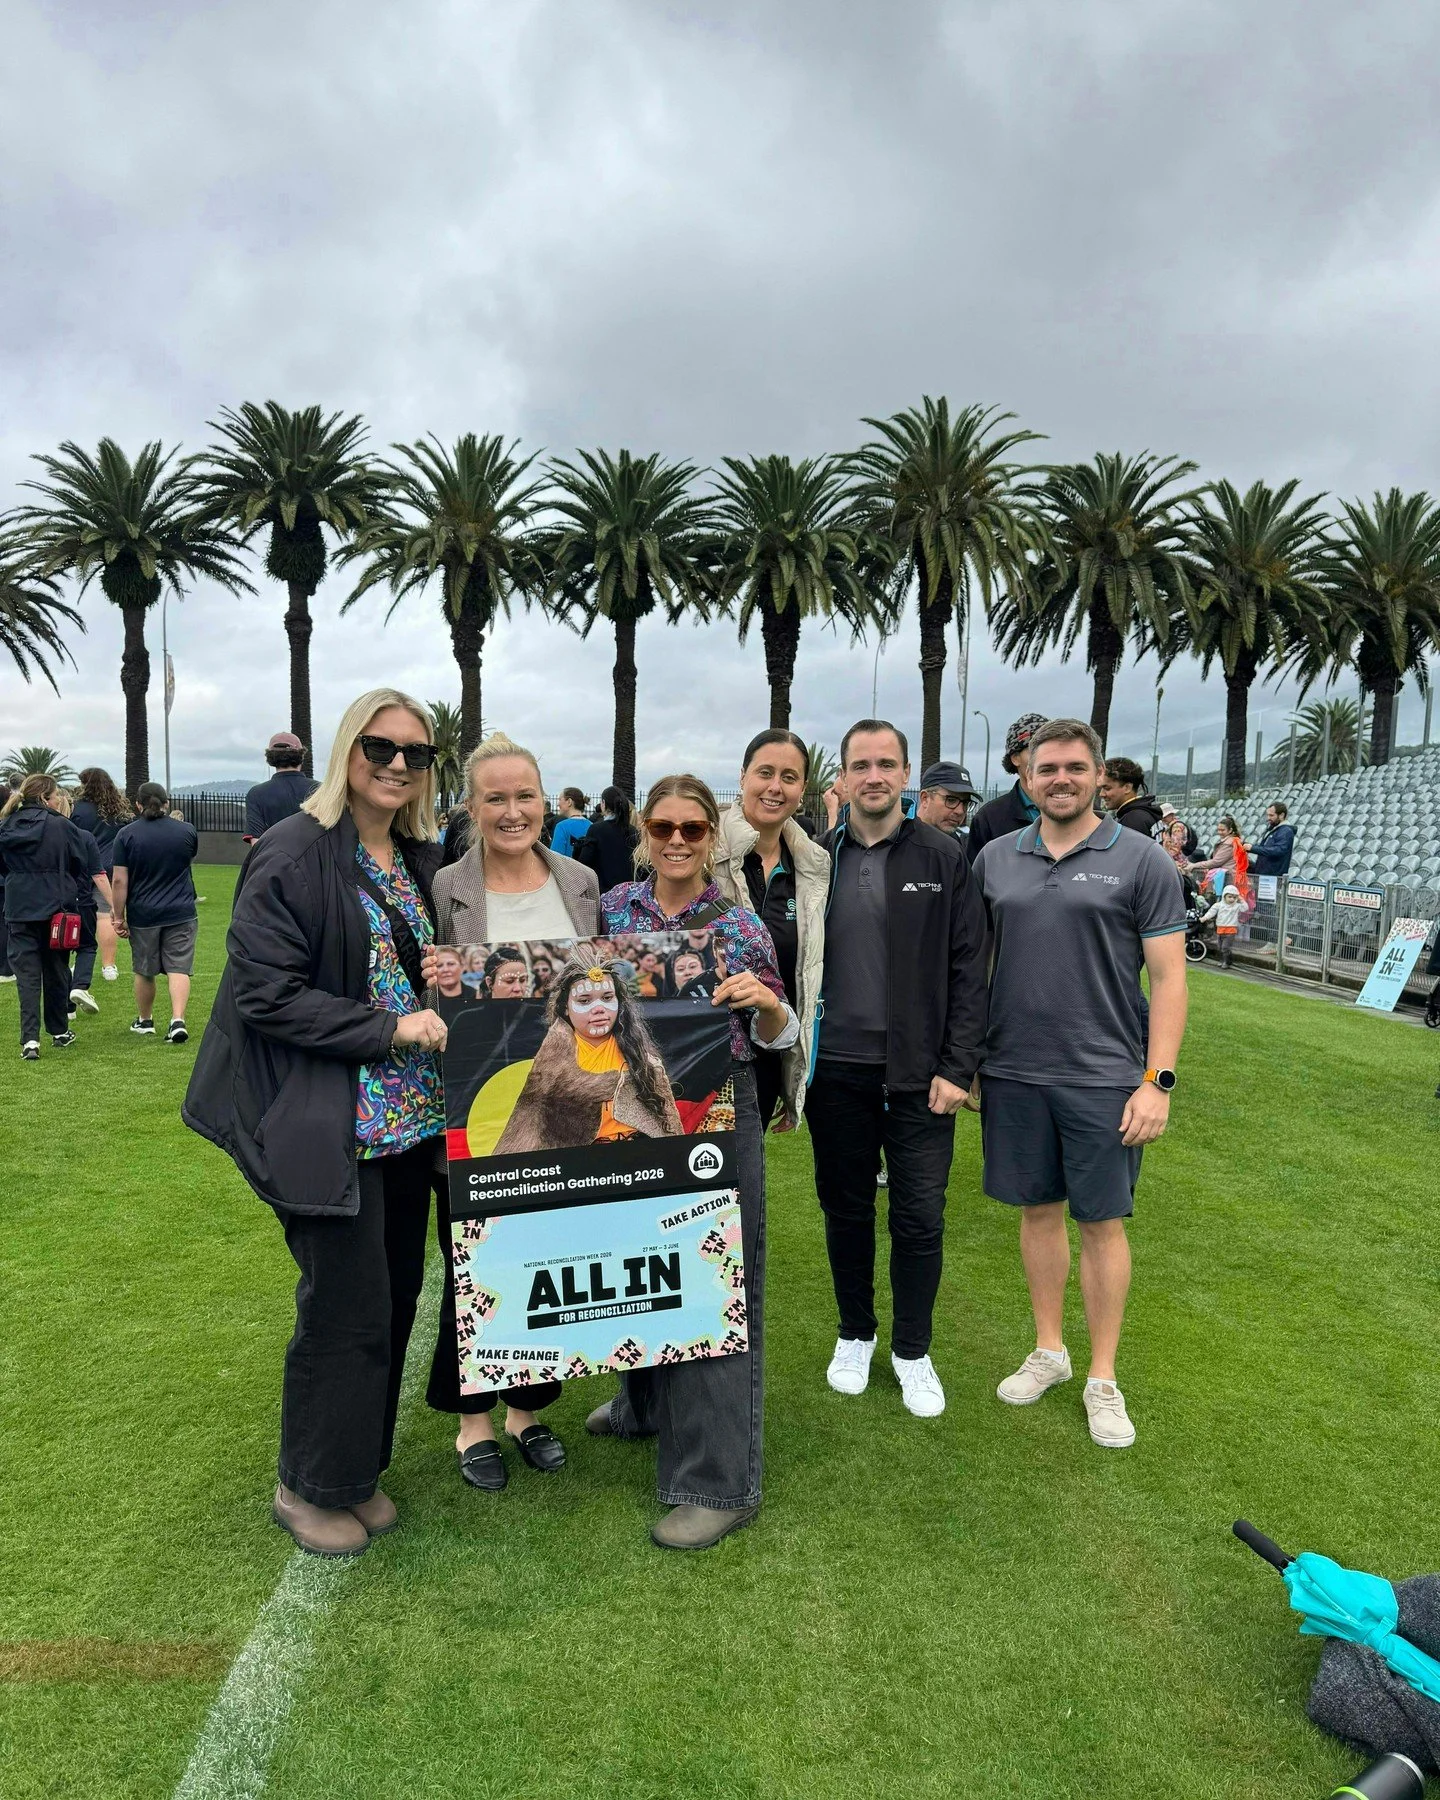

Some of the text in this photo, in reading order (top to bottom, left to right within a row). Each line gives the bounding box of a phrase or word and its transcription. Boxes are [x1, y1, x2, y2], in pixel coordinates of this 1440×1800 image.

[1290, 883, 1323, 893] FIRE EXIT
[1336, 890, 1378, 900] FIRE EXIT
[1385, 947, 1406, 962] ALL
[1378, 961, 1396, 975] IN
[468, 1164, 561, 1185] Central Coast
[469, 1168, 665, 1201] Reconciliation Gathering 2026
[661, 1211, 689, 1229] TAKE
[691, 1194, 731, 1218] ACTION
[462, 1227, 481, 1239] IN
[712, 1238, 727, 1256] IN
[523, 1260, 546, 1268] NATIONAL
[547, 1255, 586, 1265] RECONCILIATION
[527, 1262, 616, 1311] ALL
[623, 1252, 681, 1297] IN
[559, 1301, 652, 1324] FOR RECONCILIATION
[723, 1299, 744, 1321] I'M
[457, 1325, 477, 1342] IN
[476, 1348, 509, 1360] MAKE
[512, 1350, 560, 1361] CHANGE
[614, 1338, 637, 1361] I'M
[688, 1340, 711, 1357] I'M
[625, 1348, 643, 1367] IN
[506, 1369, 531, 1386] I'M
